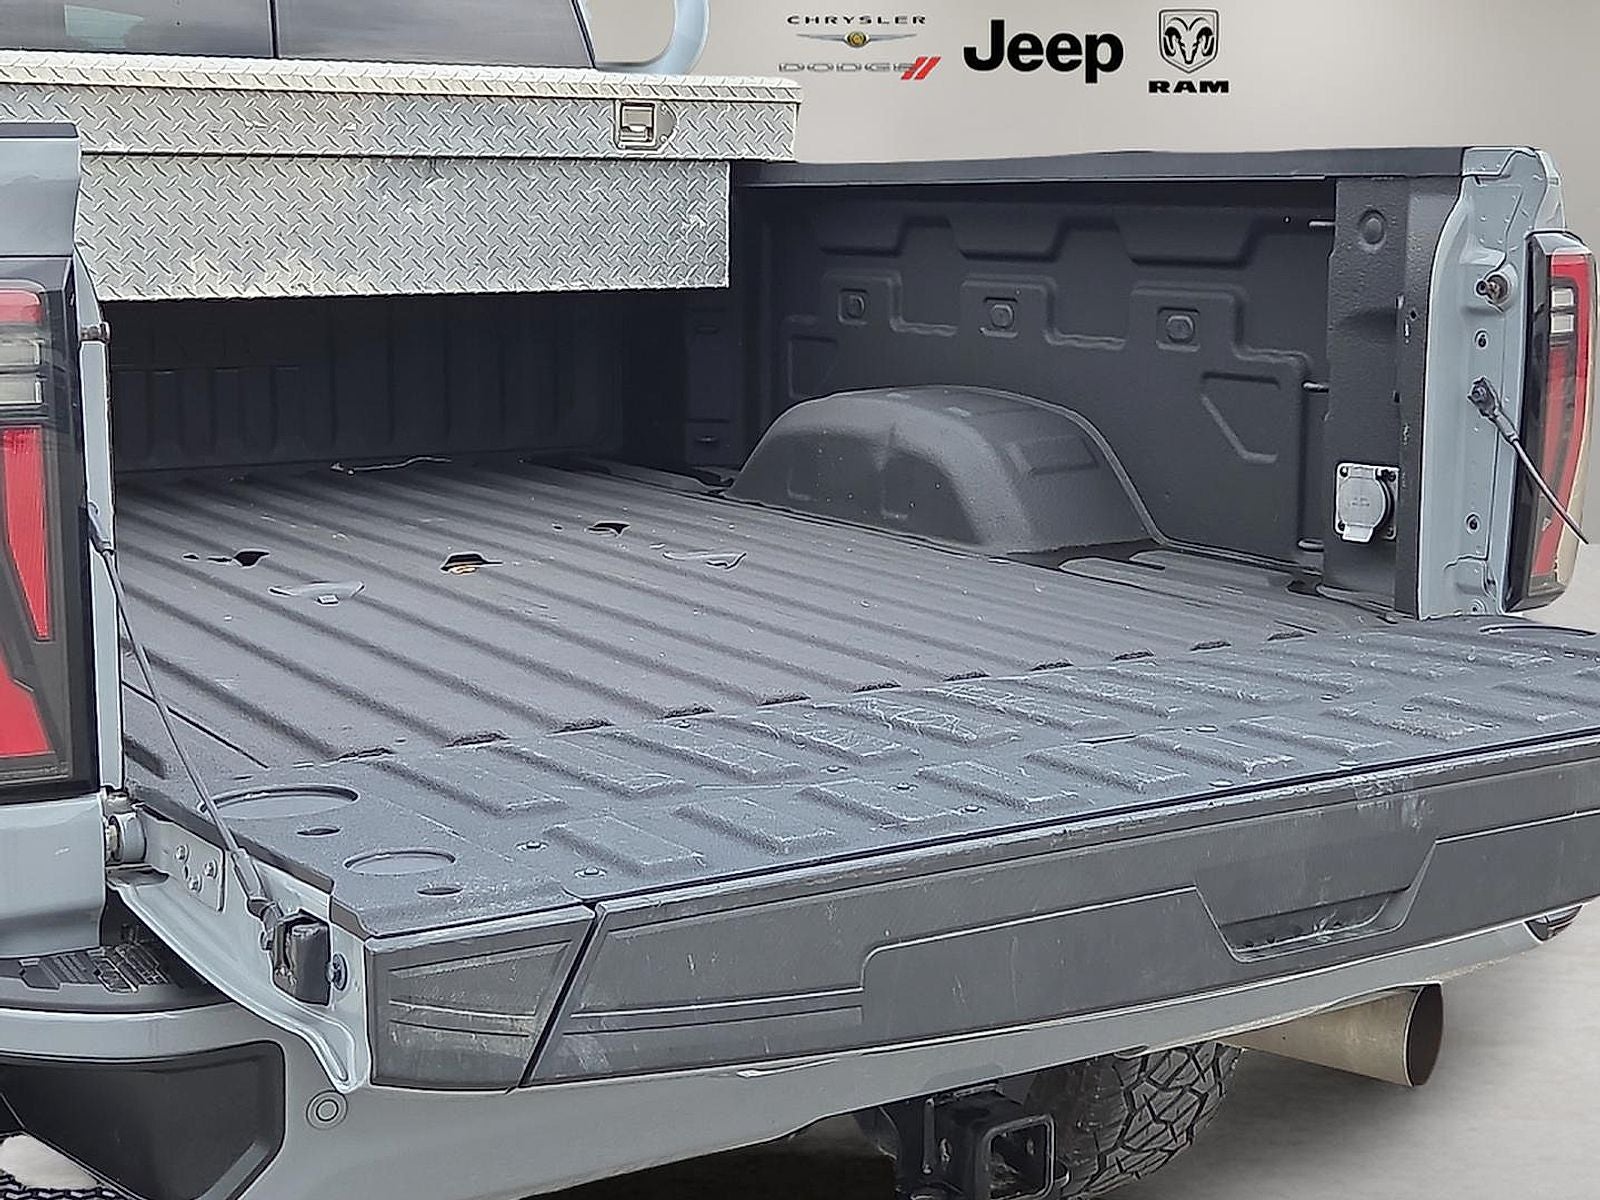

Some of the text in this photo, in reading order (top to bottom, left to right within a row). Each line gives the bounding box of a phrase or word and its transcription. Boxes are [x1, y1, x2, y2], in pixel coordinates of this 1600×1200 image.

[787, 15, 926, 25] CHRYSLER
[963, 19, 1124, 84] Jeep
[778, 62, 916, 73] DODGE
[1148, 80, 1230, 94] RAM
